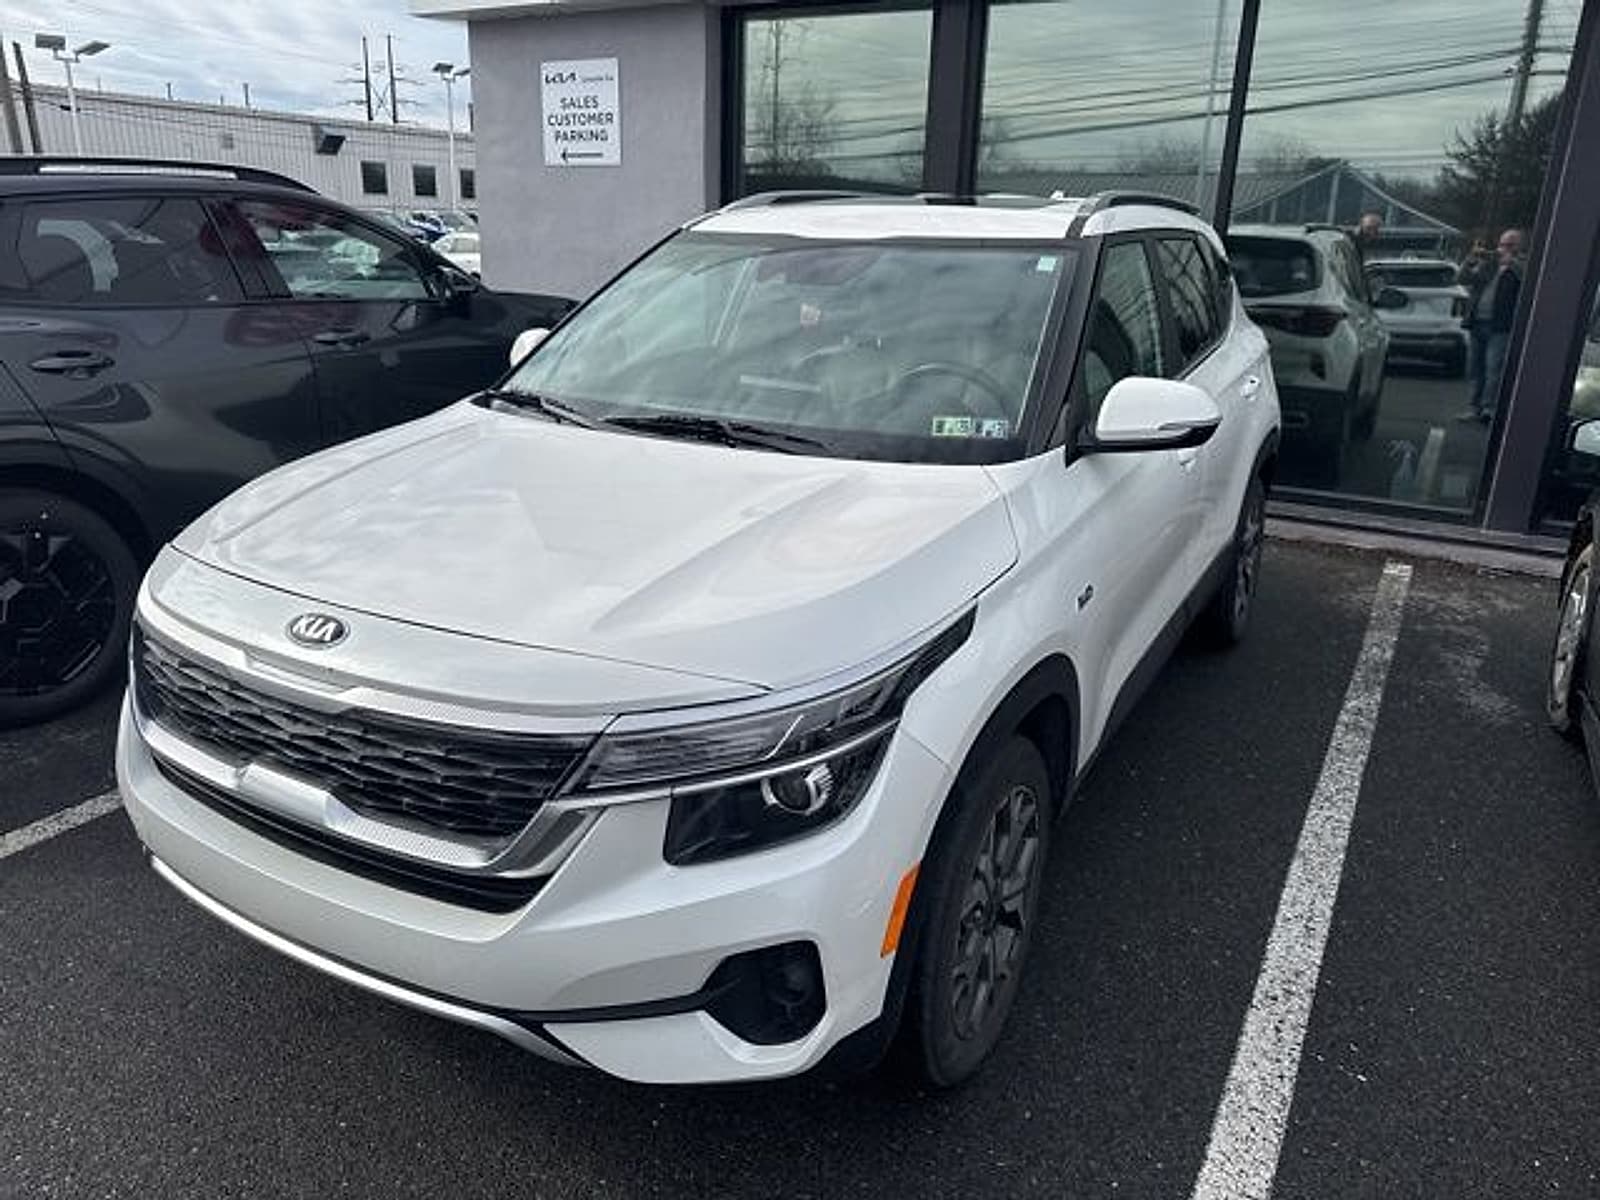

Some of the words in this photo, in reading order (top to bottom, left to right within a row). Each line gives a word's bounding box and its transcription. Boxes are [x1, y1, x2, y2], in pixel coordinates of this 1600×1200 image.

[545, 72, 576, 84] KIA
[560, 96, 599, 110] SALES
[547, 112, 614, 127] CUSTOMER
[555, 129, 609, 142] PARKING
[291, 617, 338, 641] KIA
